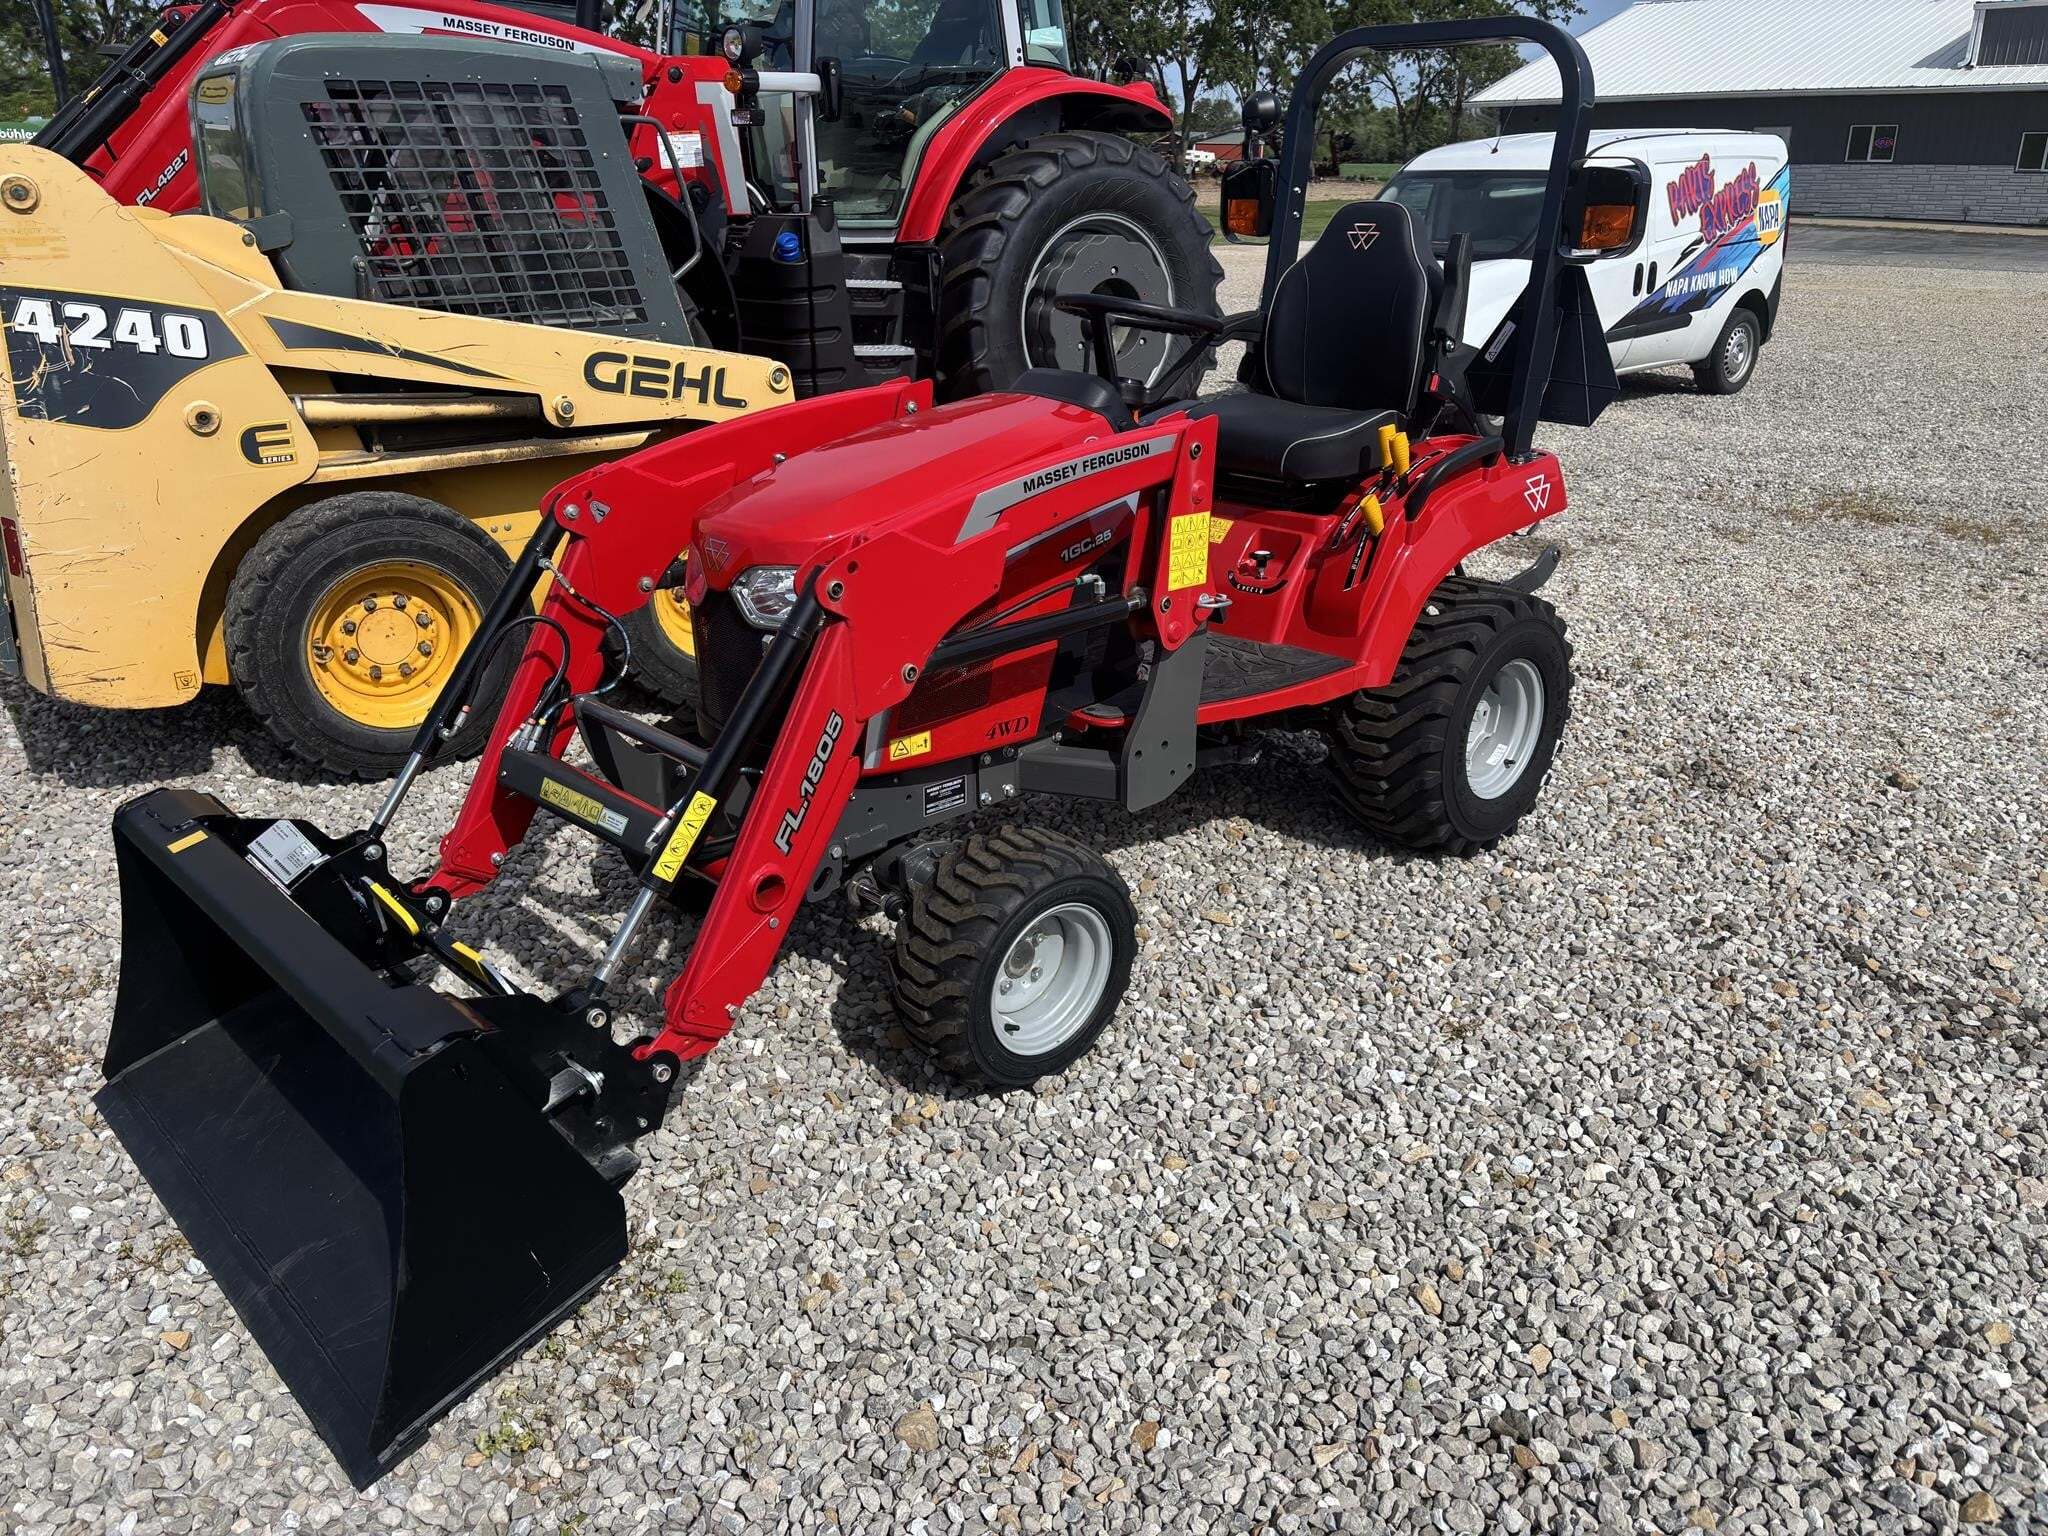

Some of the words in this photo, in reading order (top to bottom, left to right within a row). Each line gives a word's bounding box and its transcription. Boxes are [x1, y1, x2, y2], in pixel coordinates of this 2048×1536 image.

[443, 16, 501, 36] MASSEY
[504, 27, 575, 51] FERGUSON
[136, 148, 189, 207] FL.4227
[1758, 203, 1779, 231] NAPA
[1665, 278, 1688, 298] NAPA
[1690, 271, 1716, 293] KNOW
[1718, 267, 1739, 286] HOW
[12, 297, 209, 360] 4240
[584, 351, 748, 409] GEHL
[262, 454, 292, 464] SERIES
[1023, 464, 1078, 494] MASSEY
[1083, 443, 1150, 474] FERGUSON
[1060, 529, 1112, 563] 1GC.25
[985, 716, 1029, 741] 4WD
[773, 709, 843, 857] FL.1805
